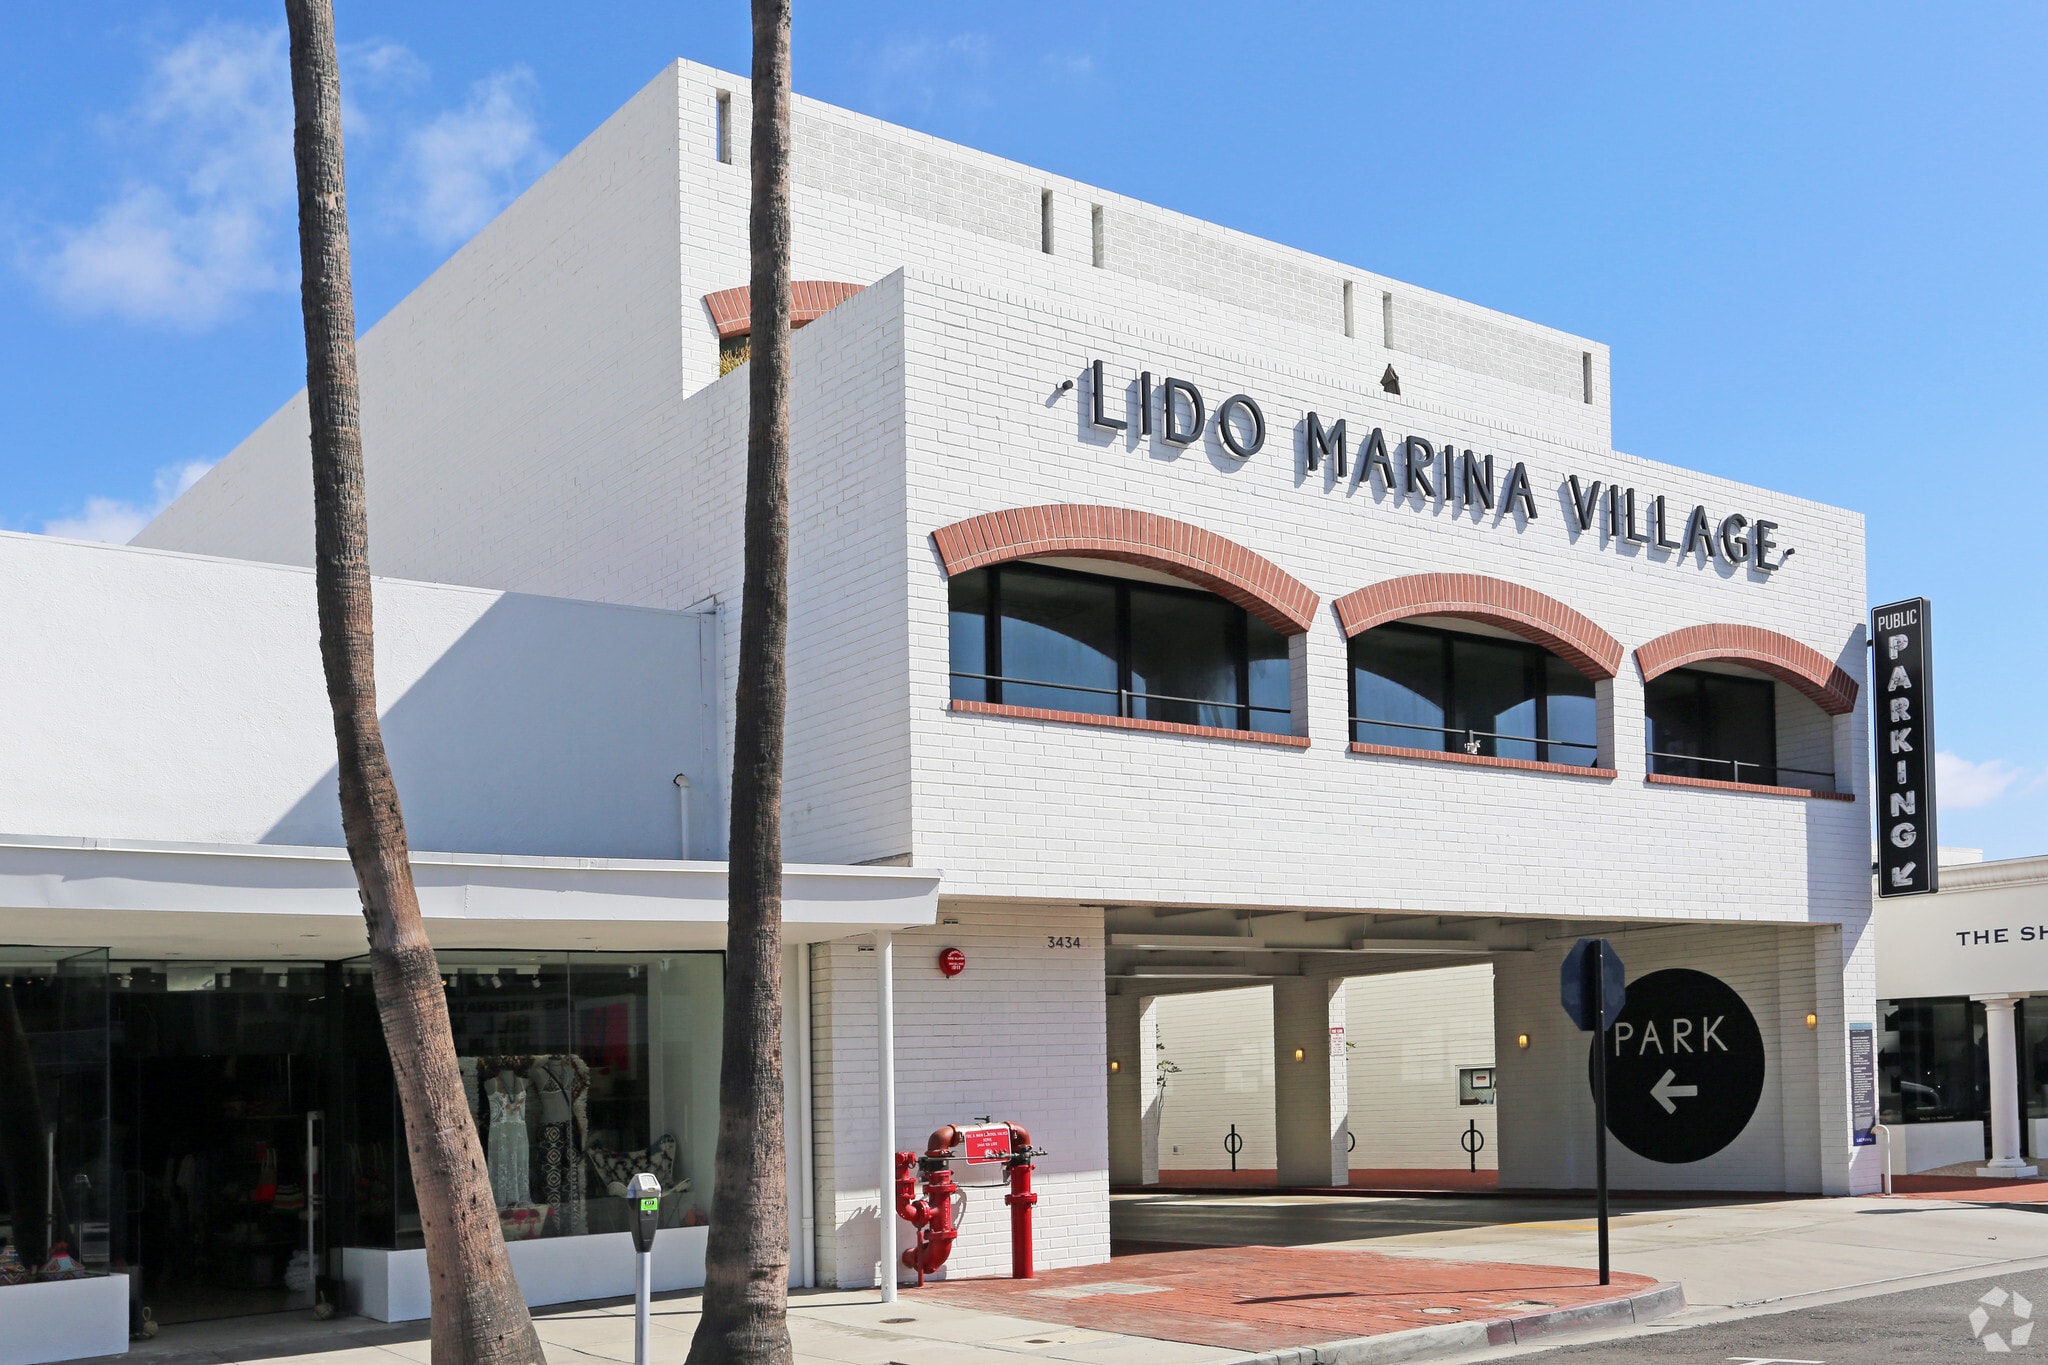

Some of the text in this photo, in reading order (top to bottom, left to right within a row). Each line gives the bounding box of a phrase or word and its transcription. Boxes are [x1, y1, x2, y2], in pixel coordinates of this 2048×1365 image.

[1091, 358, 1779, 573] LIDO MARINA VILLAGE
[1877, 609, 1918, 632] PUBLIC
[1887, 633, 1917, 848] PARKING
[1047, 936, 1081, 948] 3434
[1955, 928, 2009, 946] THE
[1615, 1015, 1729, 1057] PARK
